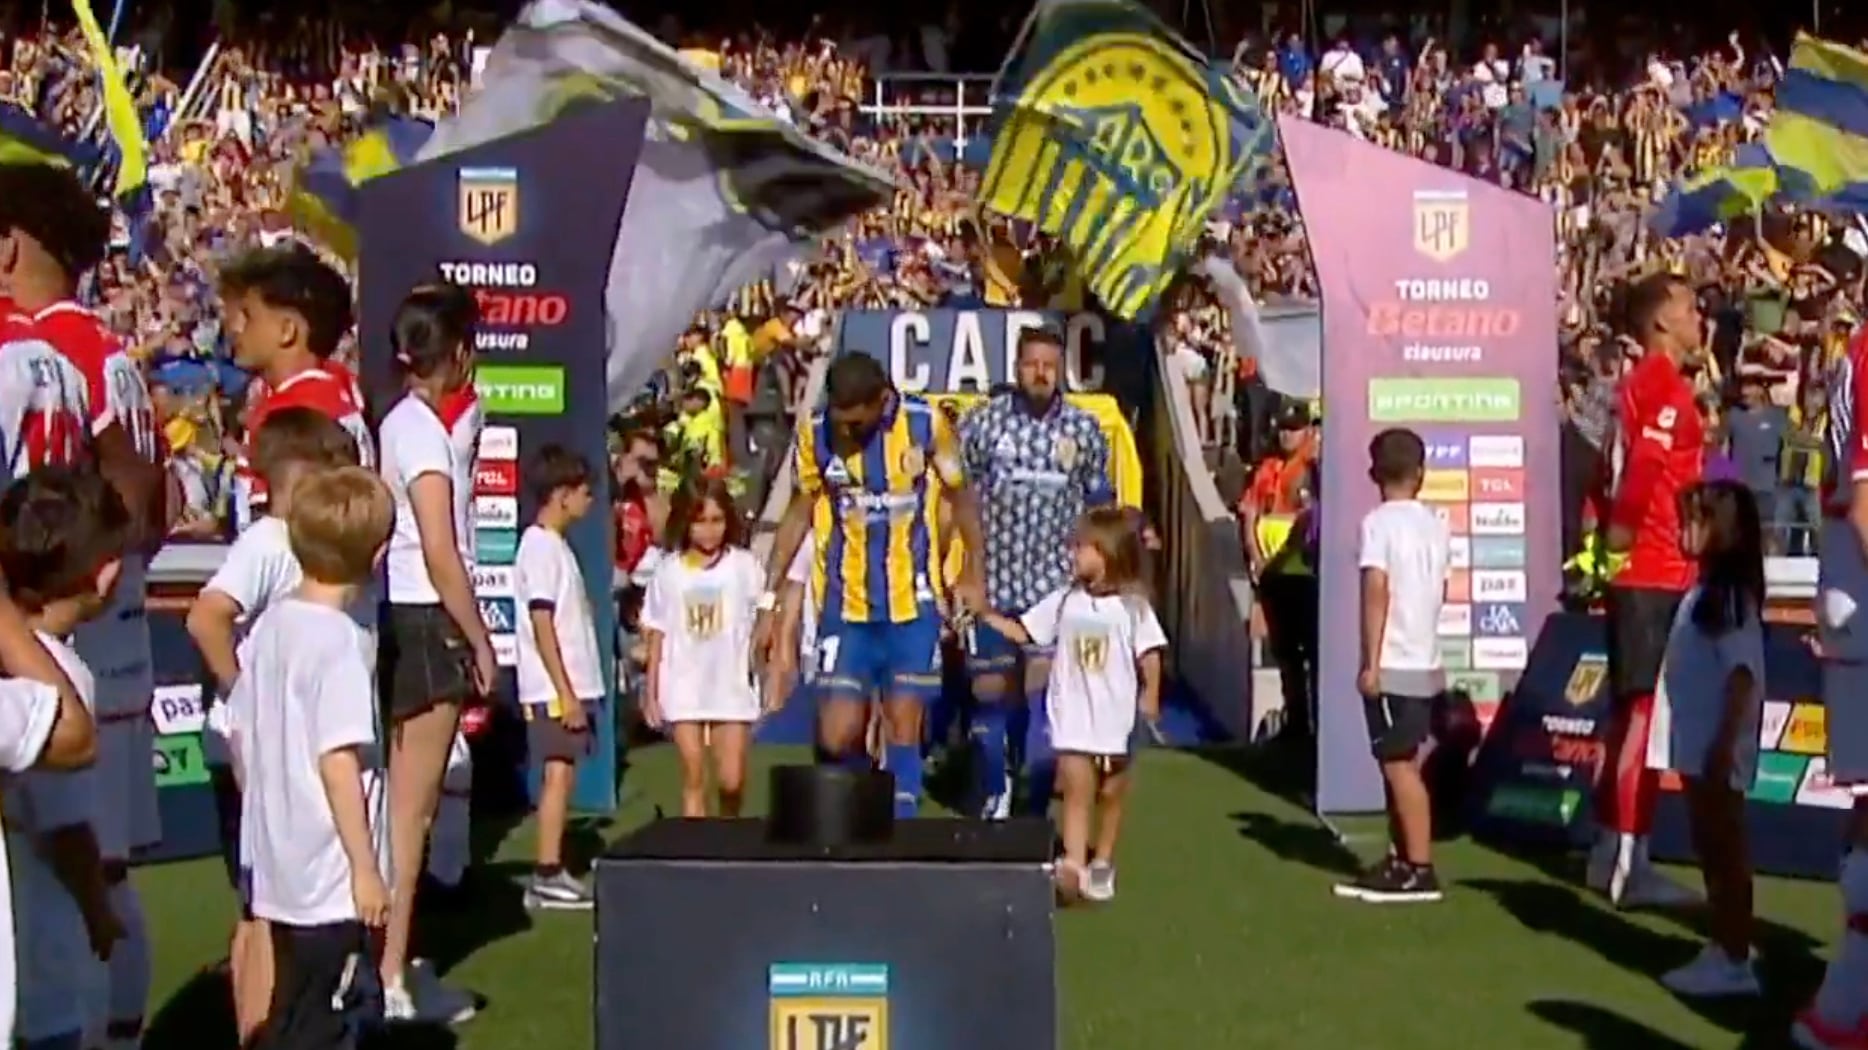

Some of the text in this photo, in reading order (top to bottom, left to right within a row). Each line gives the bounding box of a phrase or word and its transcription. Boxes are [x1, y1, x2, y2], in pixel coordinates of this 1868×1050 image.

[466, 189, 509, 235] LPF
[1421, 210, 1459, 252] LPF
[440, 262, 537, 286] TORNEO
[1396, 279, 1489, 300] TORNEO
[474, 291, 568, 326] tano
[1367, 303, 1520, 337] Betano
[475, 331, 529, 351] usura
[1376, 393, 1512, 411] SPORTING
